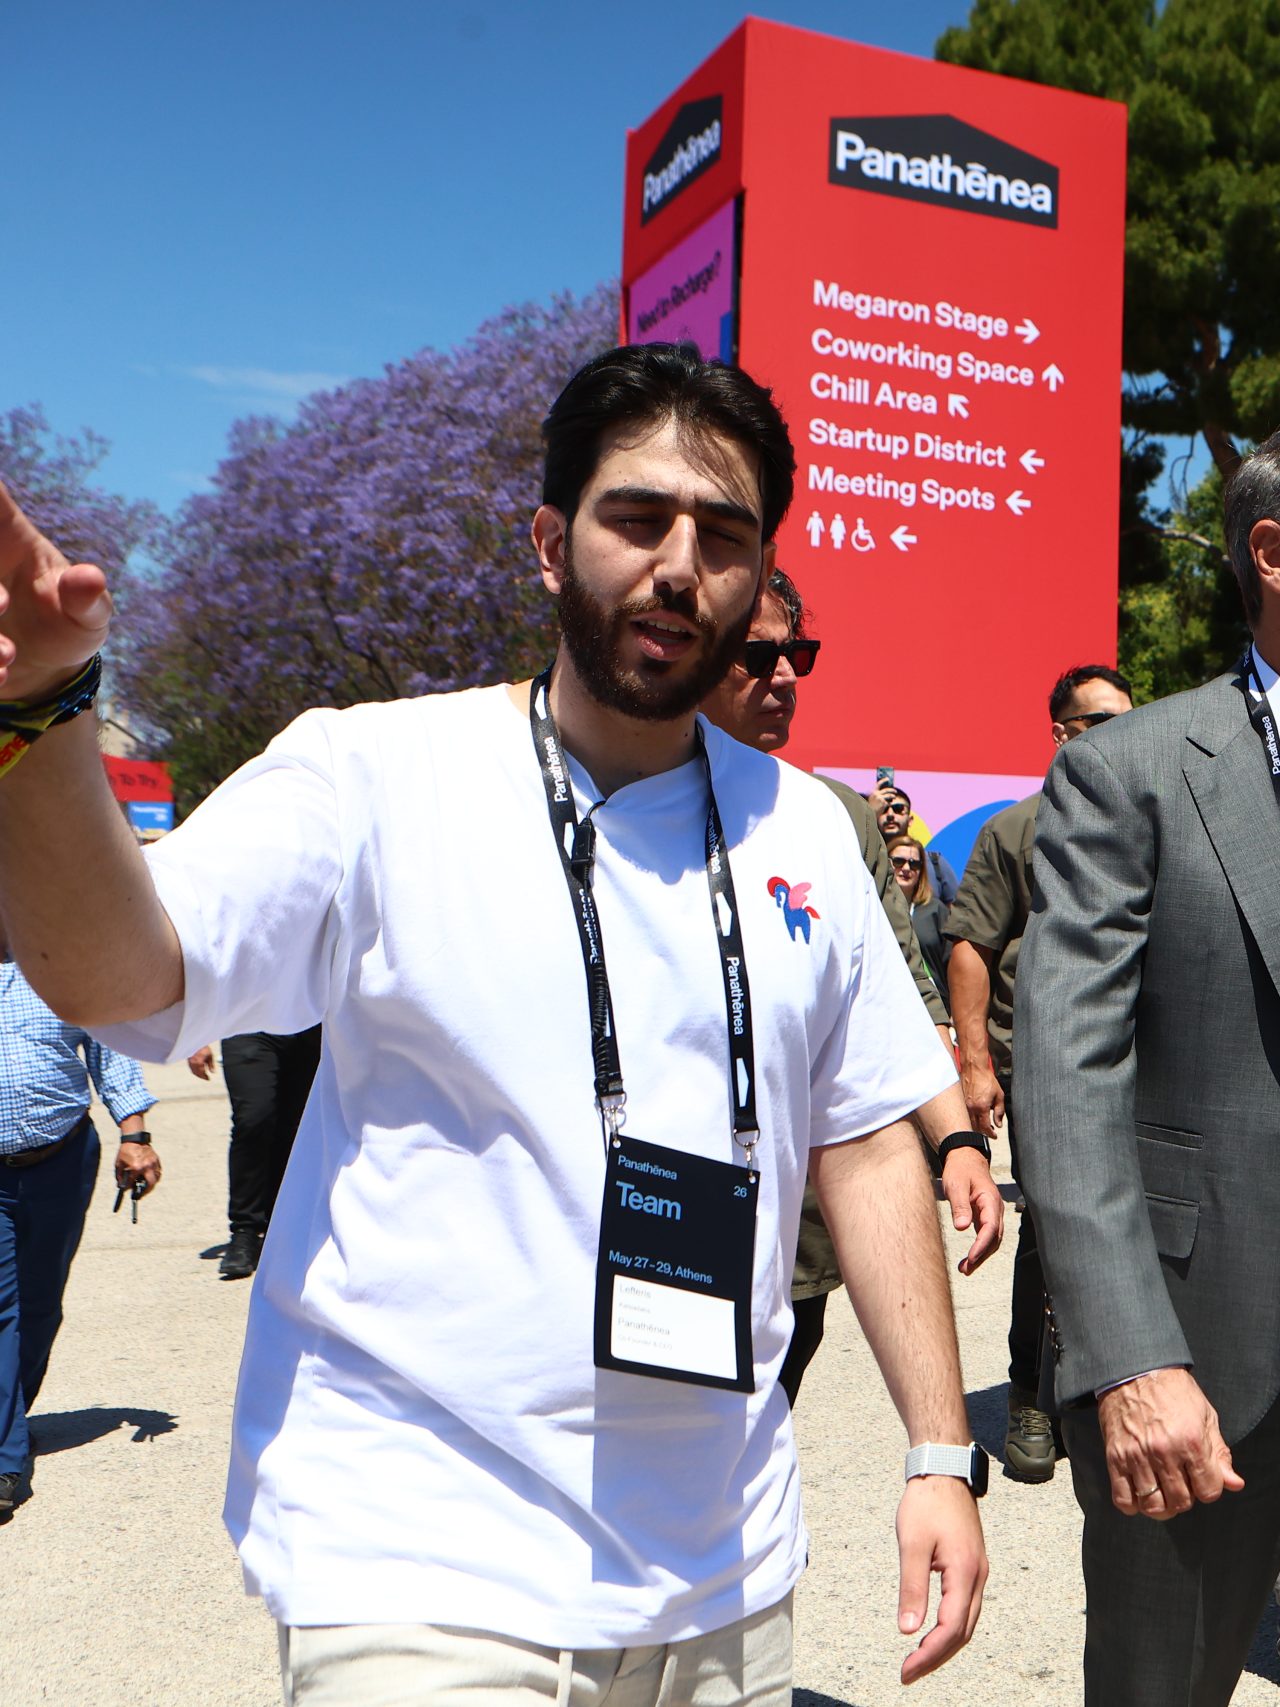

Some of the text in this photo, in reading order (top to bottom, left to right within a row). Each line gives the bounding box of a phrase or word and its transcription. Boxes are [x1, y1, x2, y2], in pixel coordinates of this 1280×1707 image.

[835, 130, 1053, 214] Panathēnea
[813, 279, 1009, 340] Megaron Stage
[811, 328, 1034, 386] Coworking Space
[810, 372, 938, 415] Chill Area
[808, 417, 1007, 468] Startup District
[808, 463, 995, 511] Meeting Spots
[543, 735, 569, 803] Panathēnea
[726, 956, 745, 1036] Panathēnea
[617, 1154, 678, 1181] Panathēnea
[733, 1185, 748, 1198] 26
[615, 1180, 682, 1221] Team
[608, 1249, 632, 1268] May
[675, 1265, 713, 1284] Athens
